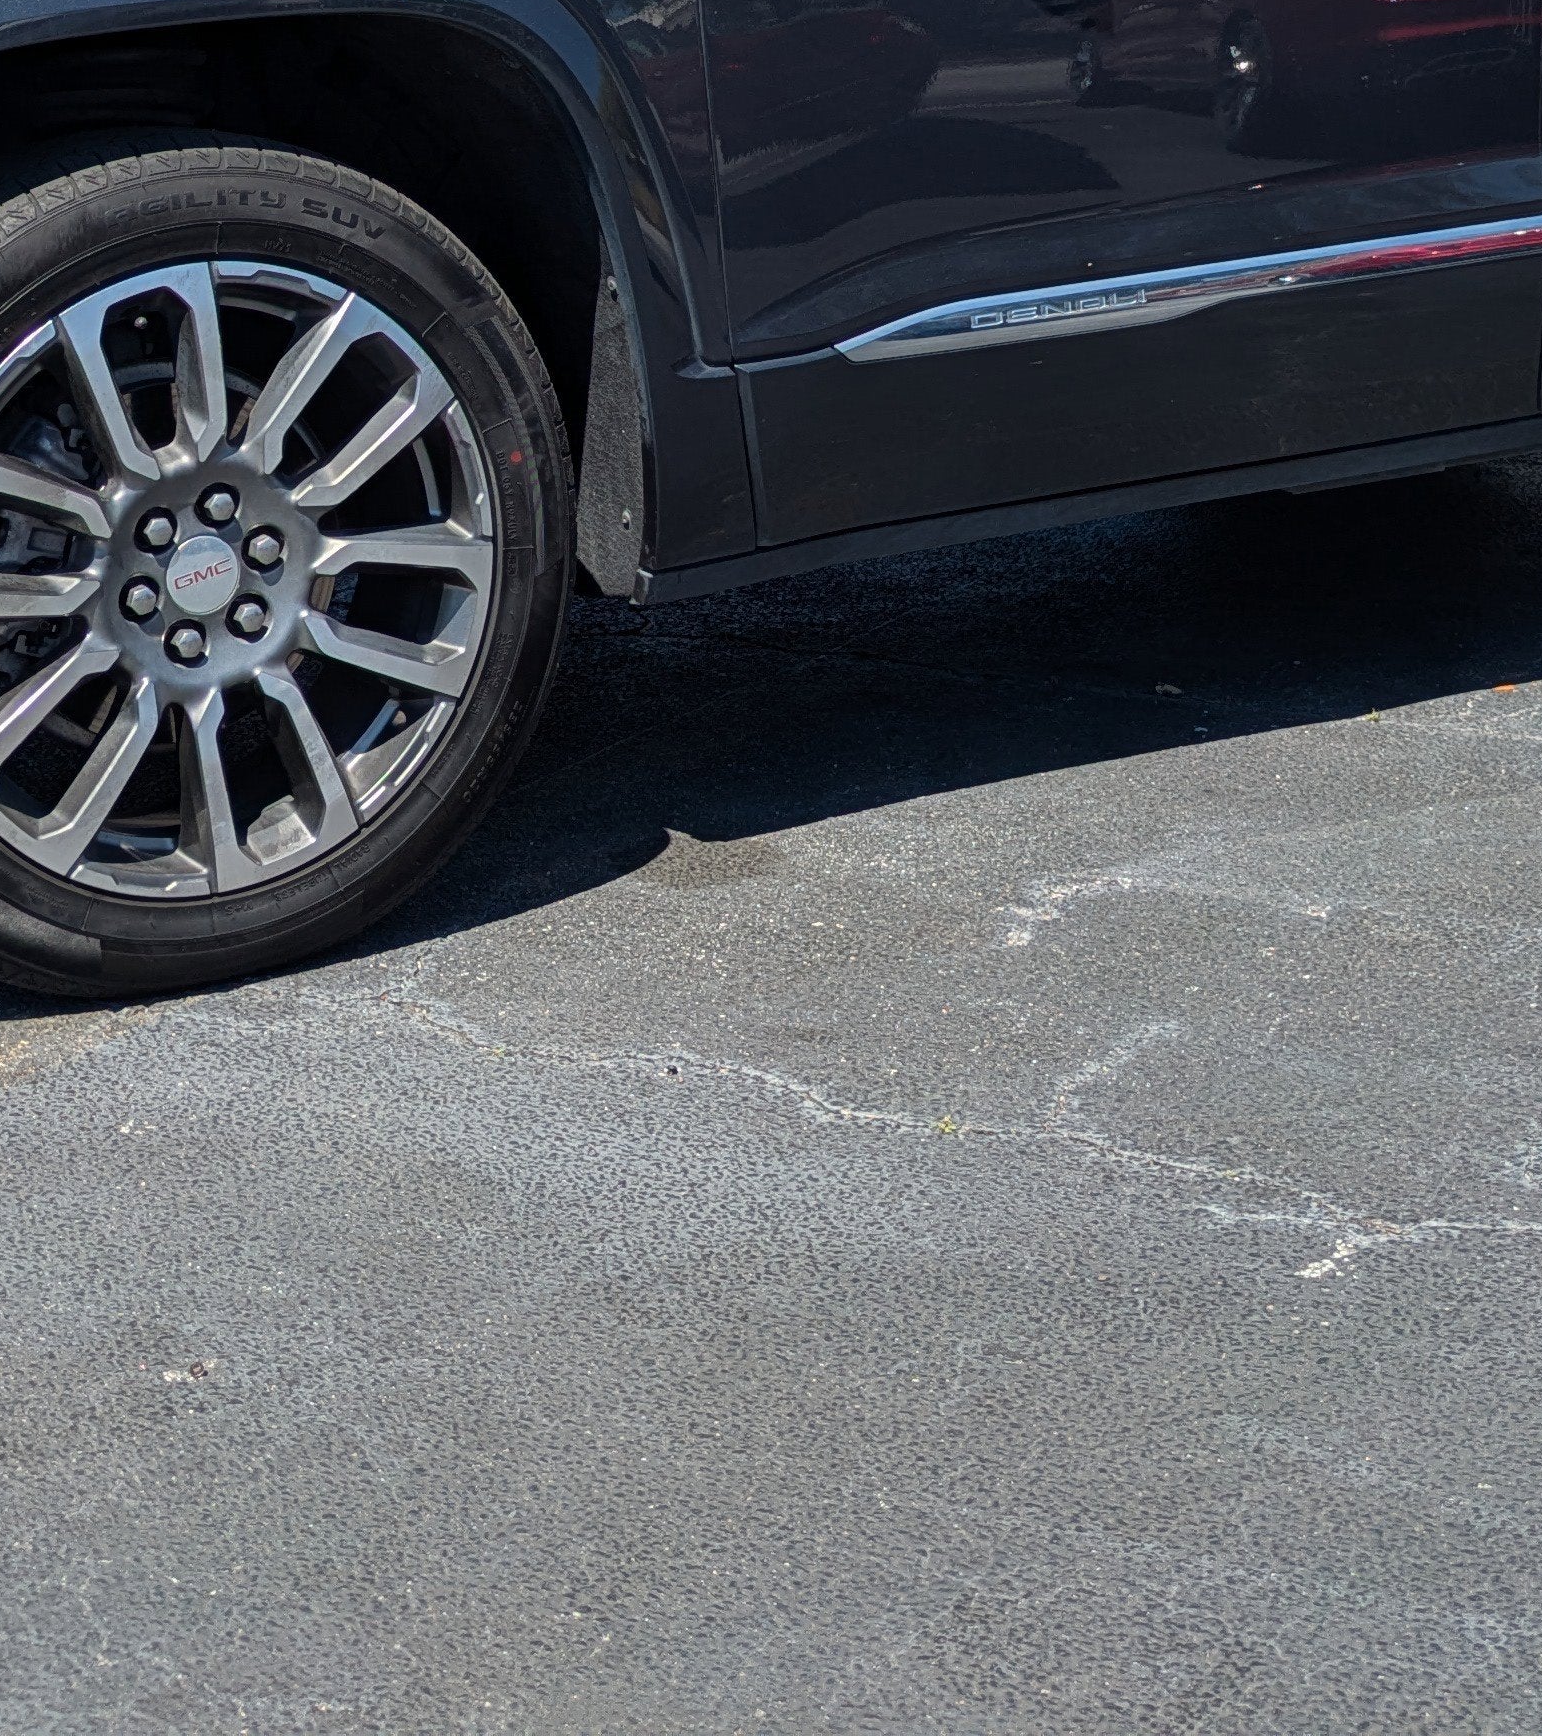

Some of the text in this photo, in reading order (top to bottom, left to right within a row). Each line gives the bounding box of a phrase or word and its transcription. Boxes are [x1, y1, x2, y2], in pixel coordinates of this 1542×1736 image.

[301, 196, 387, 241] SUV
[970, 288, 1148, 330] DENALI
[174, 558, 233, 591] GMC
